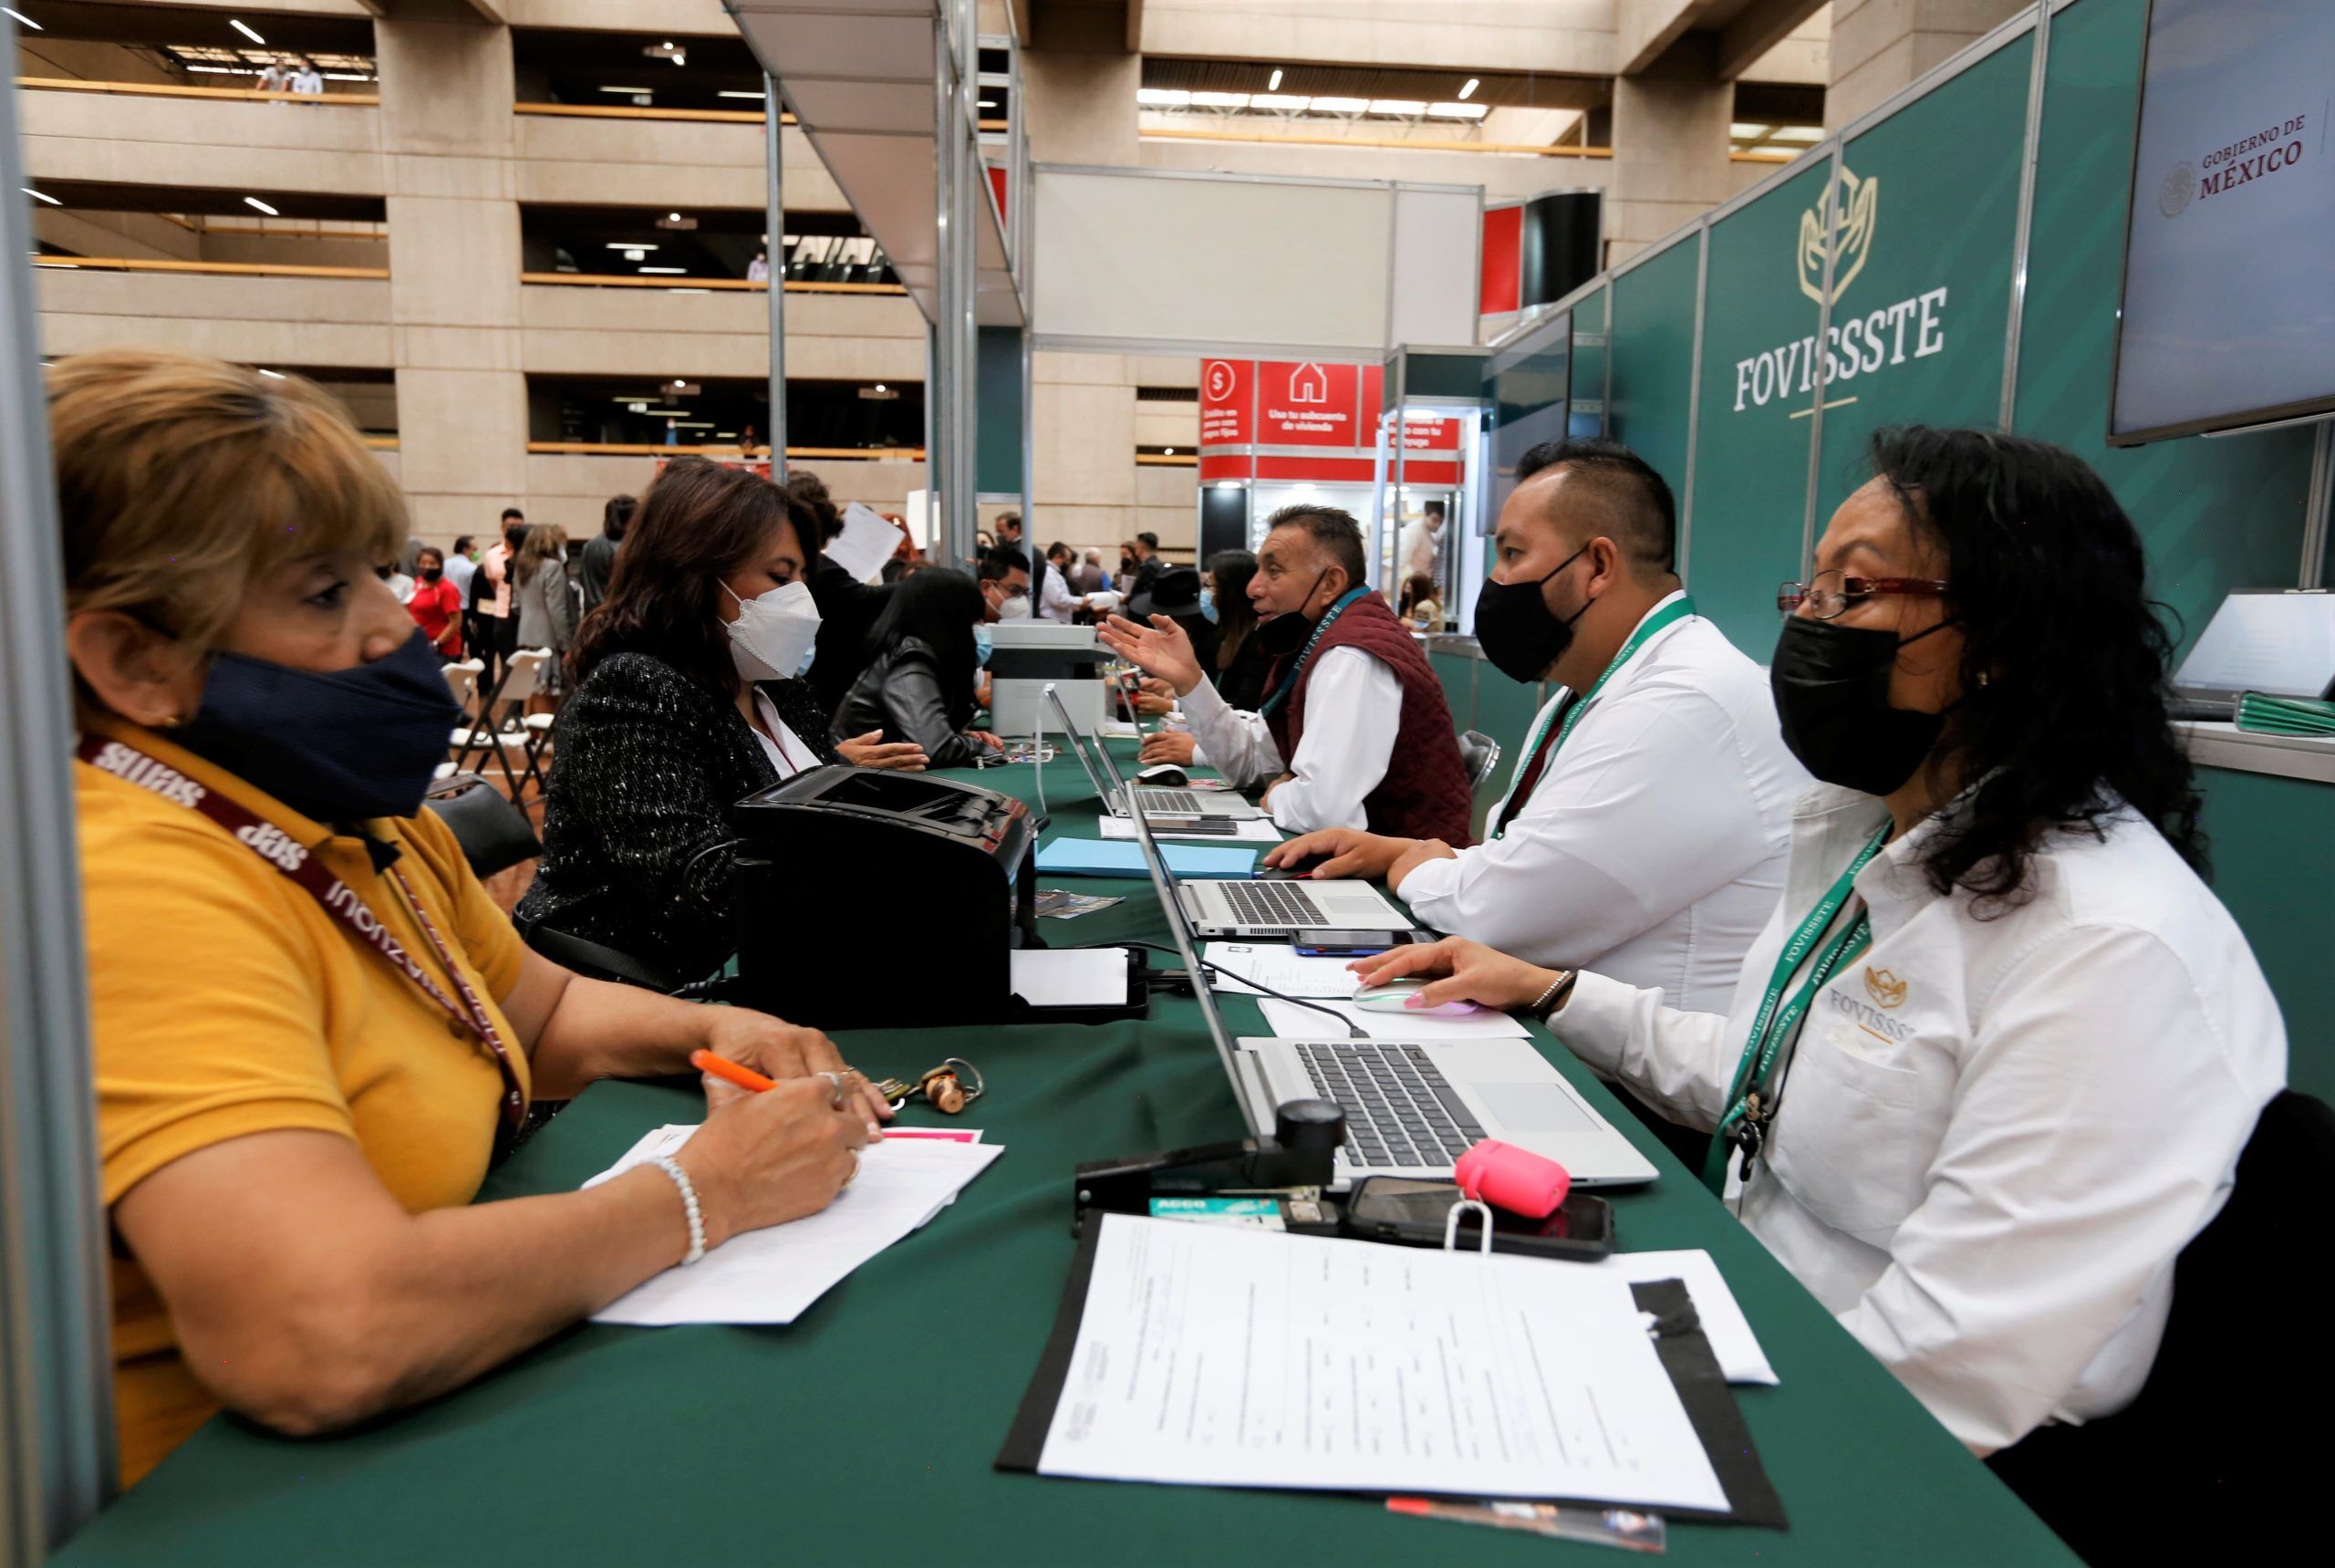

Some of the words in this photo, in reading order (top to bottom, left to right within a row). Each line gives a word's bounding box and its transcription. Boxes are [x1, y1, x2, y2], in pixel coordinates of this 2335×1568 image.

[2199, 140, 2302, 200] MÉXICO
[2203, 126, 2279, 169] GOBIERNO
[2283, 114, 2306, 136] DE
[1734, 286, 1947, 411] FOVISSSTE
[1293, 605, 1342, 670] FOVISSSTE
[1784, 900, 1835, 963] FOVISSSTE
